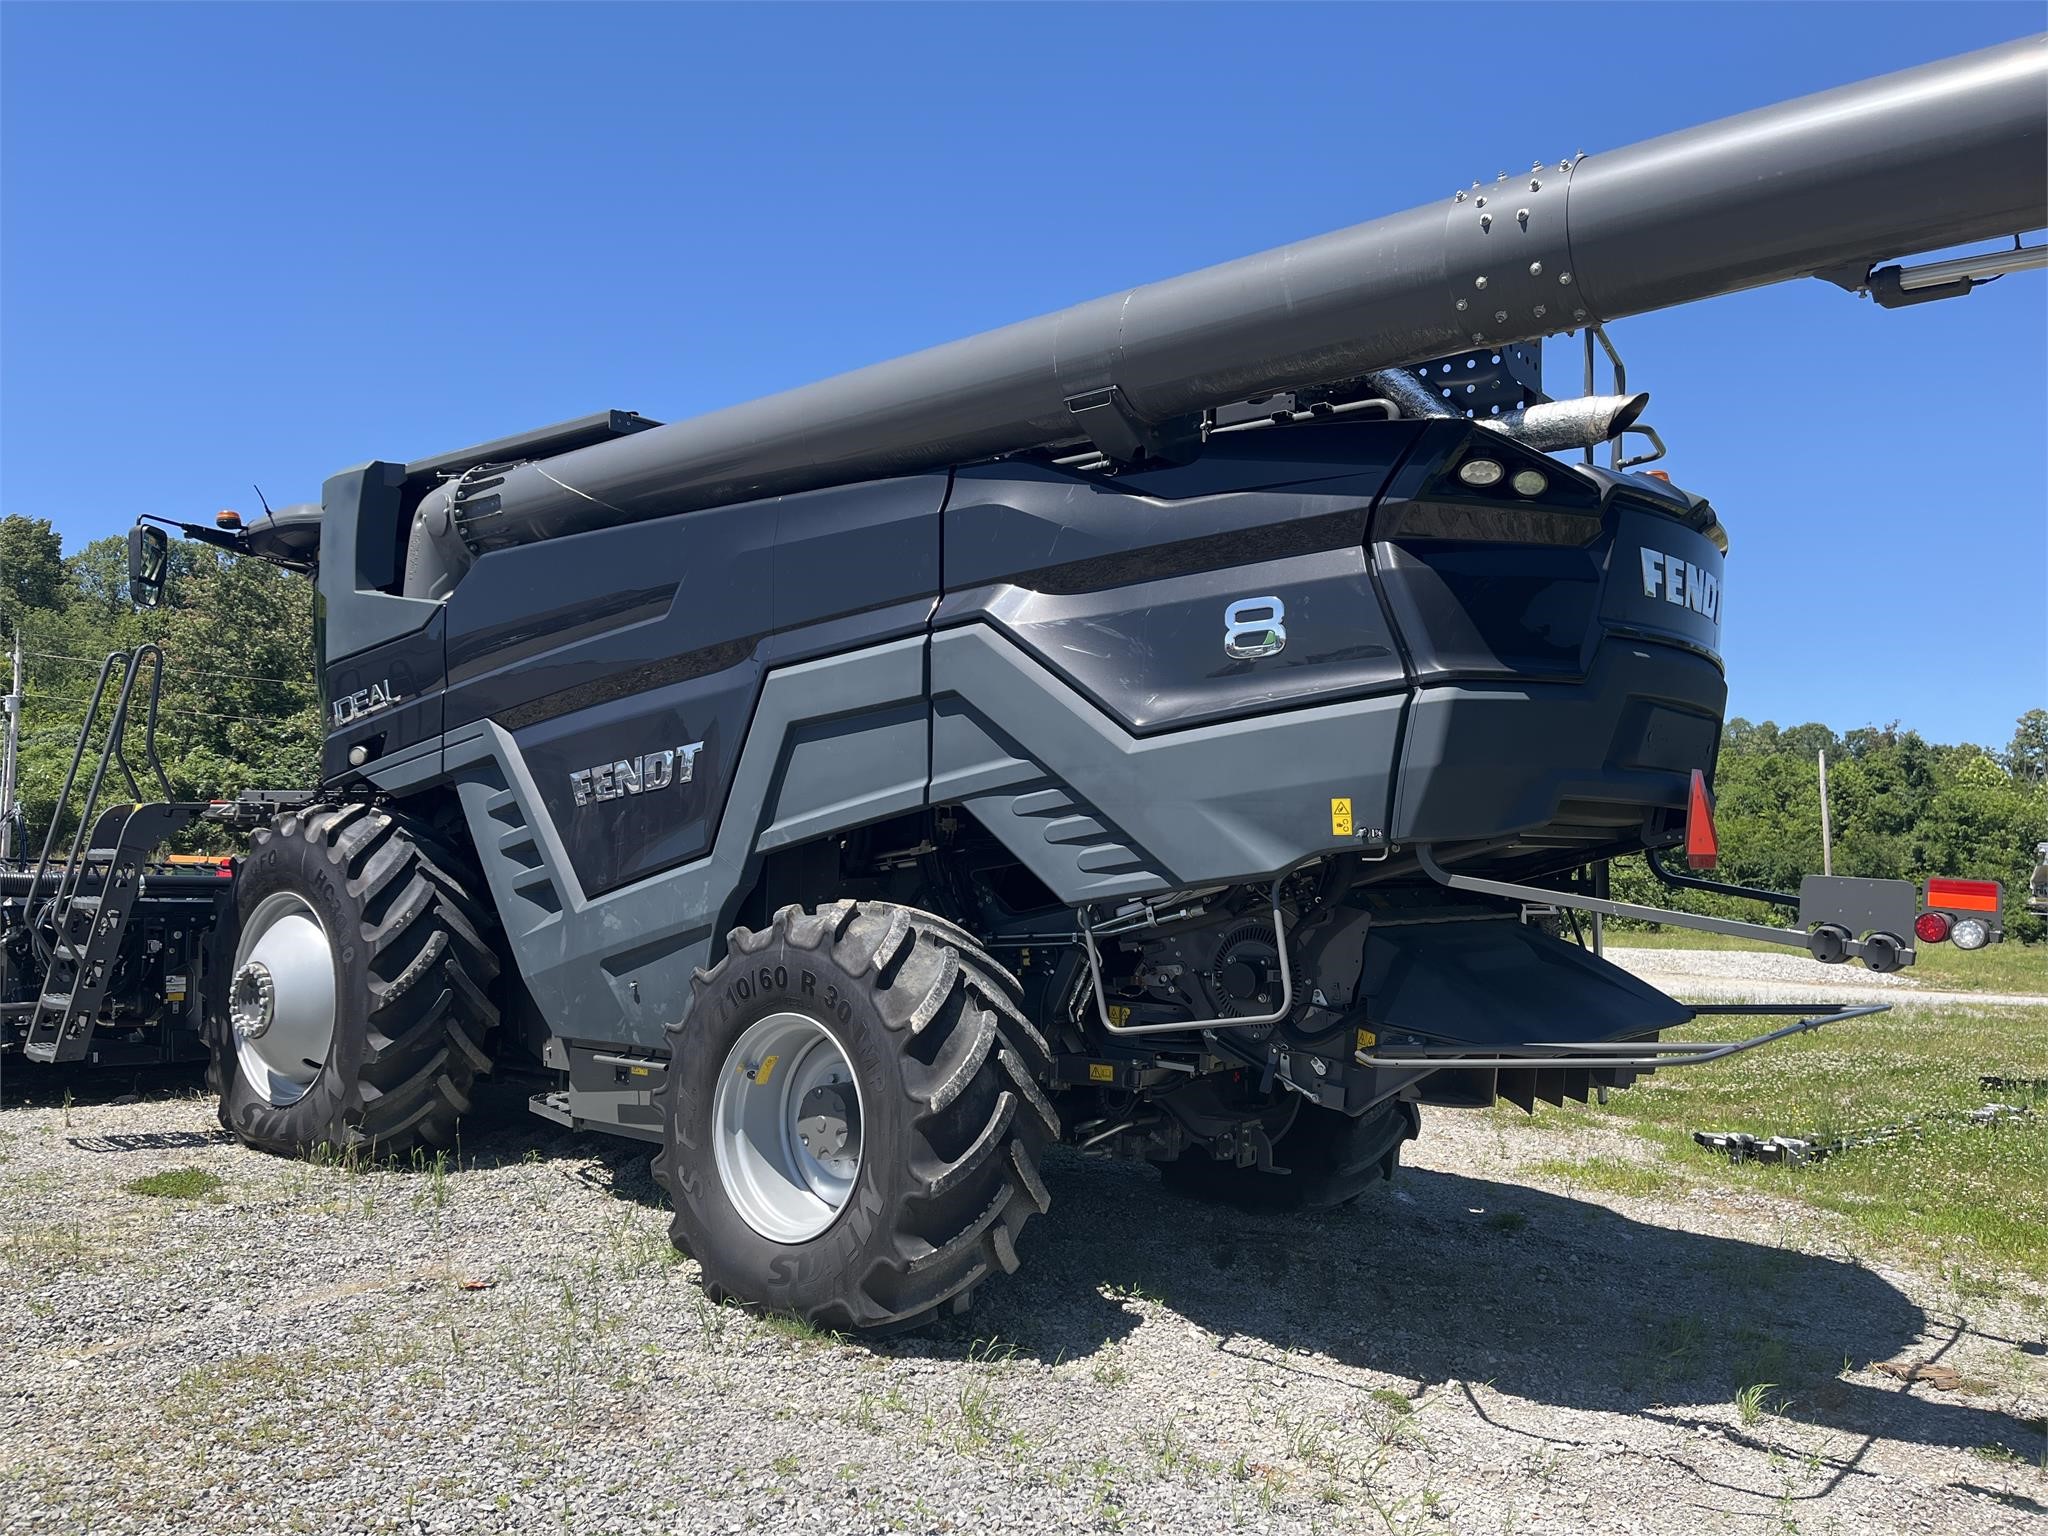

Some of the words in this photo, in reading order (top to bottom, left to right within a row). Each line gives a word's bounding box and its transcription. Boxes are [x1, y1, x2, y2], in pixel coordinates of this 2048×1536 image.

[1224, 596, 1287, 659] 8
[331, 678, 401, 727] IDEAL
[569, 741, 704, 807] FENDT
[800, 968, 818, 1001] R
[823, 984, 853, 1025] 30
